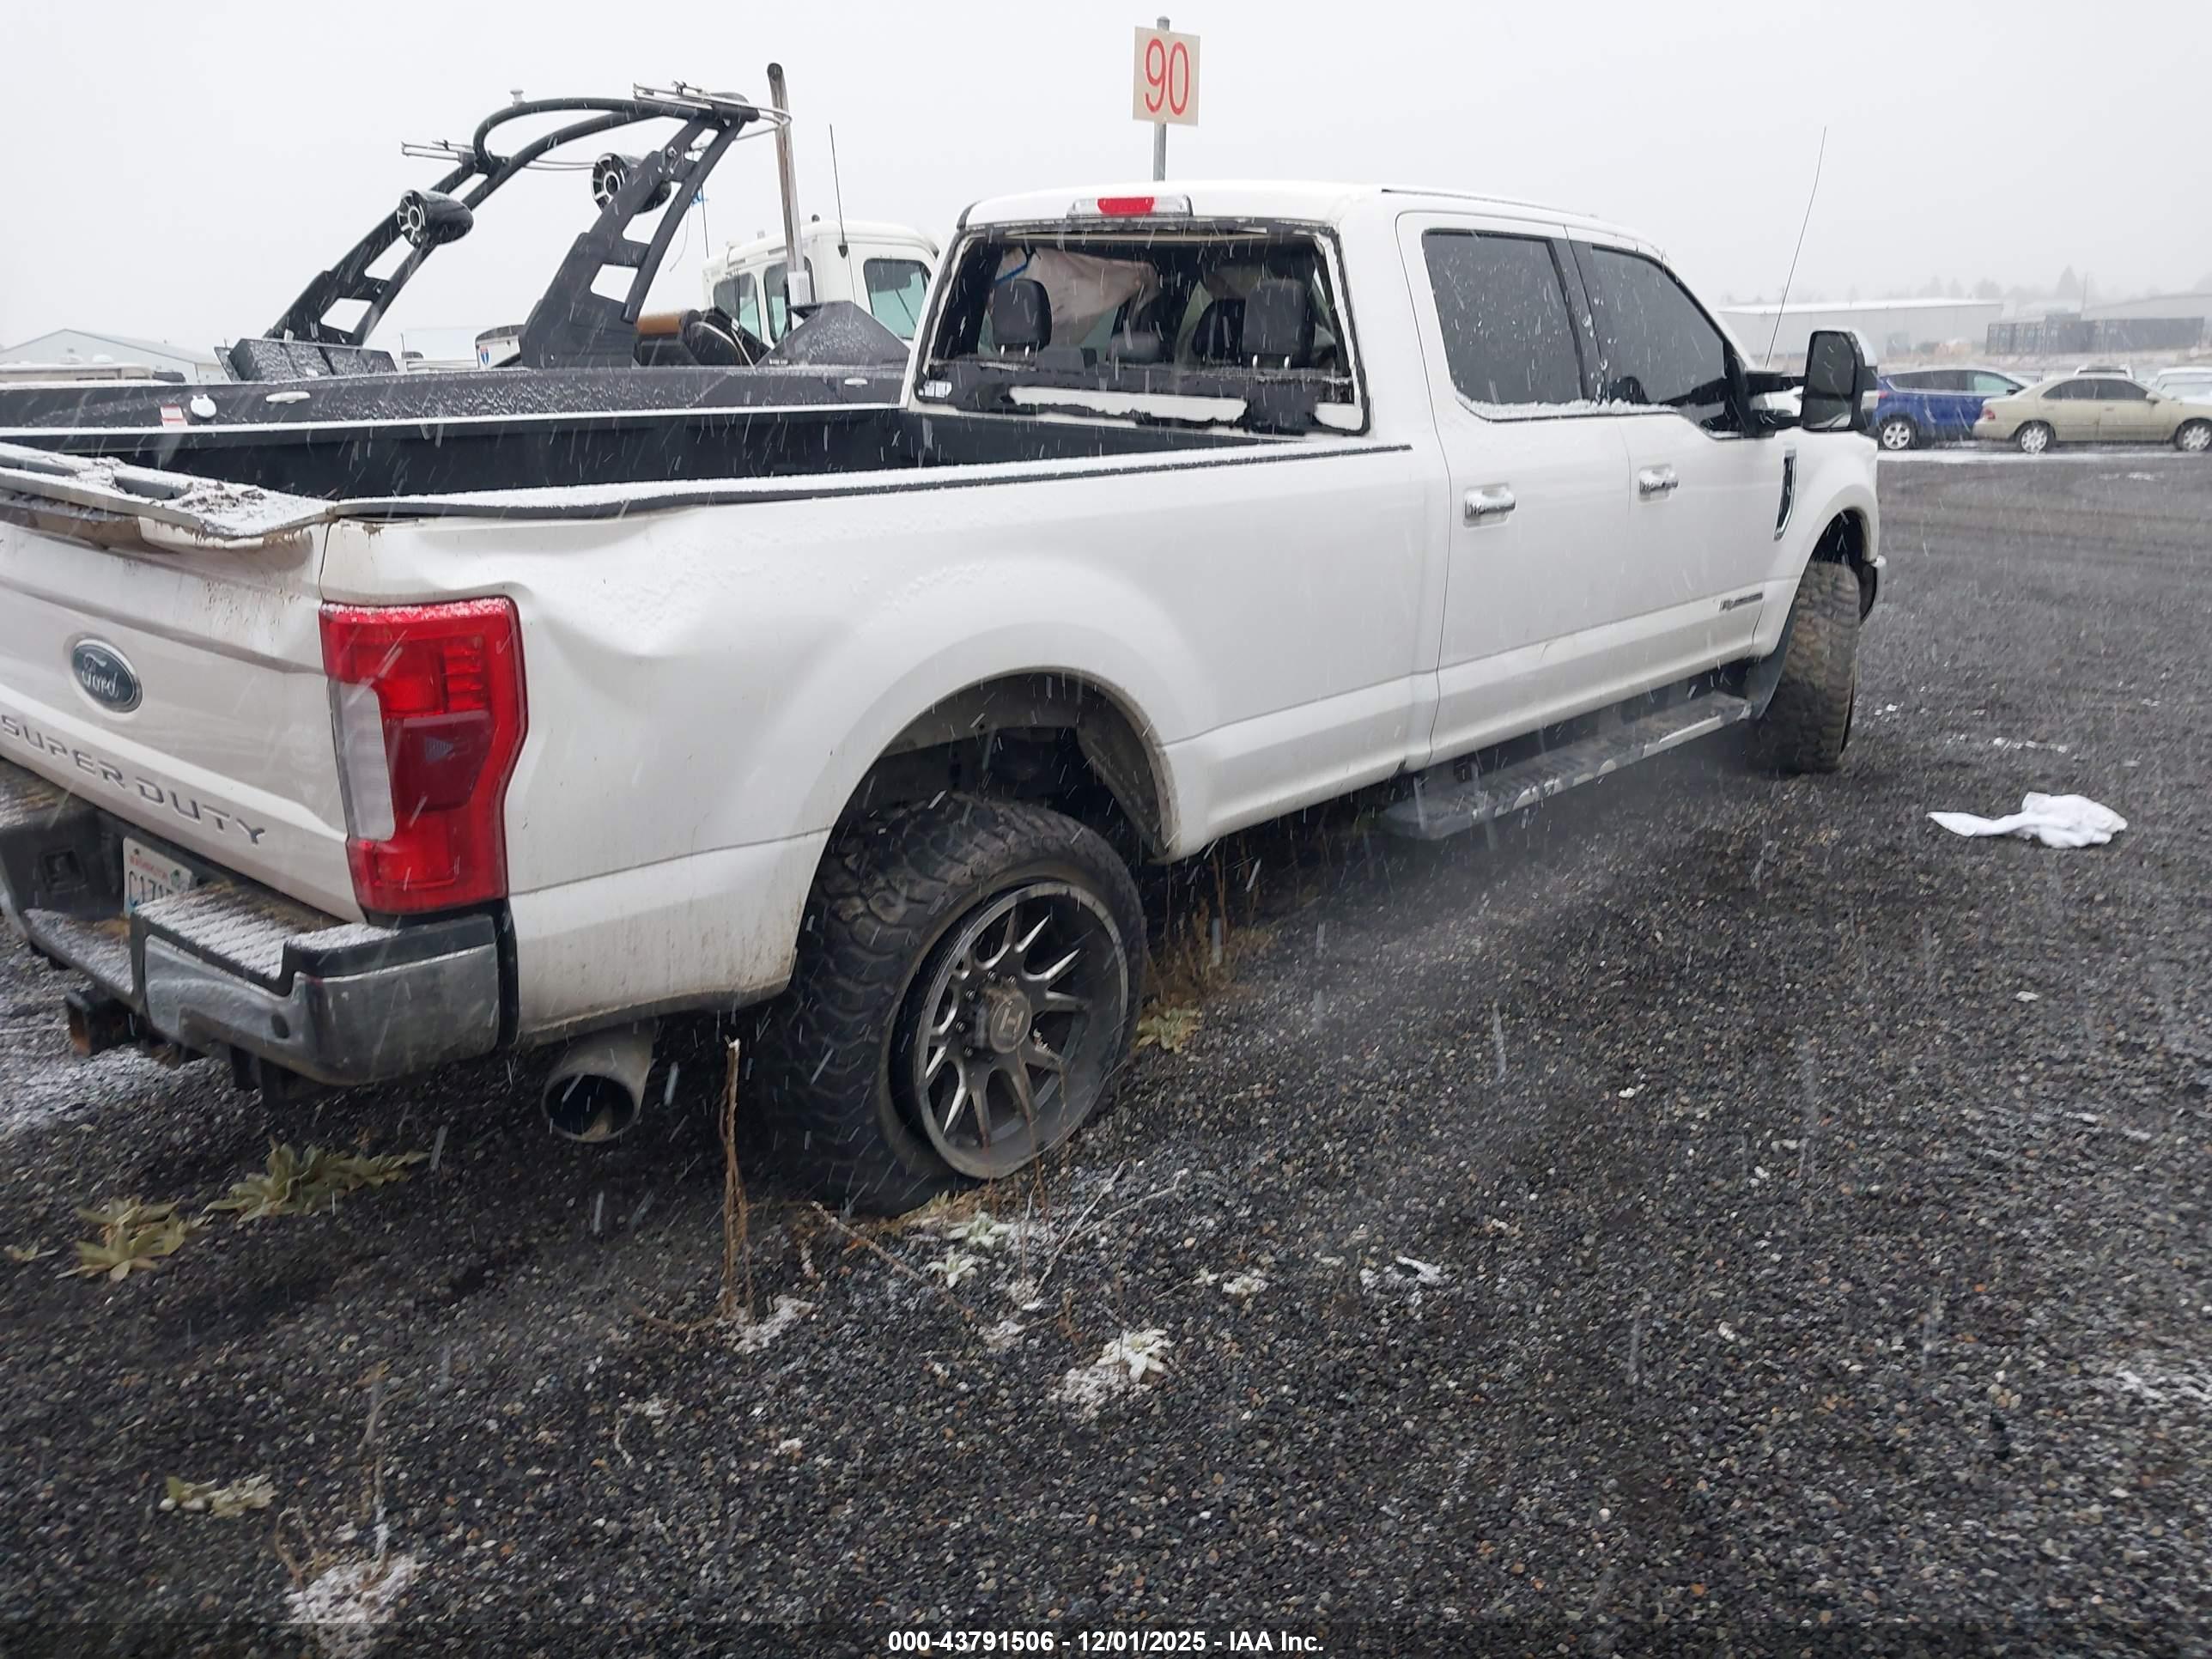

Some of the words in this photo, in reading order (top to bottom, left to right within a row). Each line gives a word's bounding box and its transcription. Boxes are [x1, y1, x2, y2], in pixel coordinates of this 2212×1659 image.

[1145, 38, 1189, 115] 90
[82, 652, 119, 699] Ford
[1, 714, 125, 790] SUPER
[135, 776, 265, 845] DUTY
